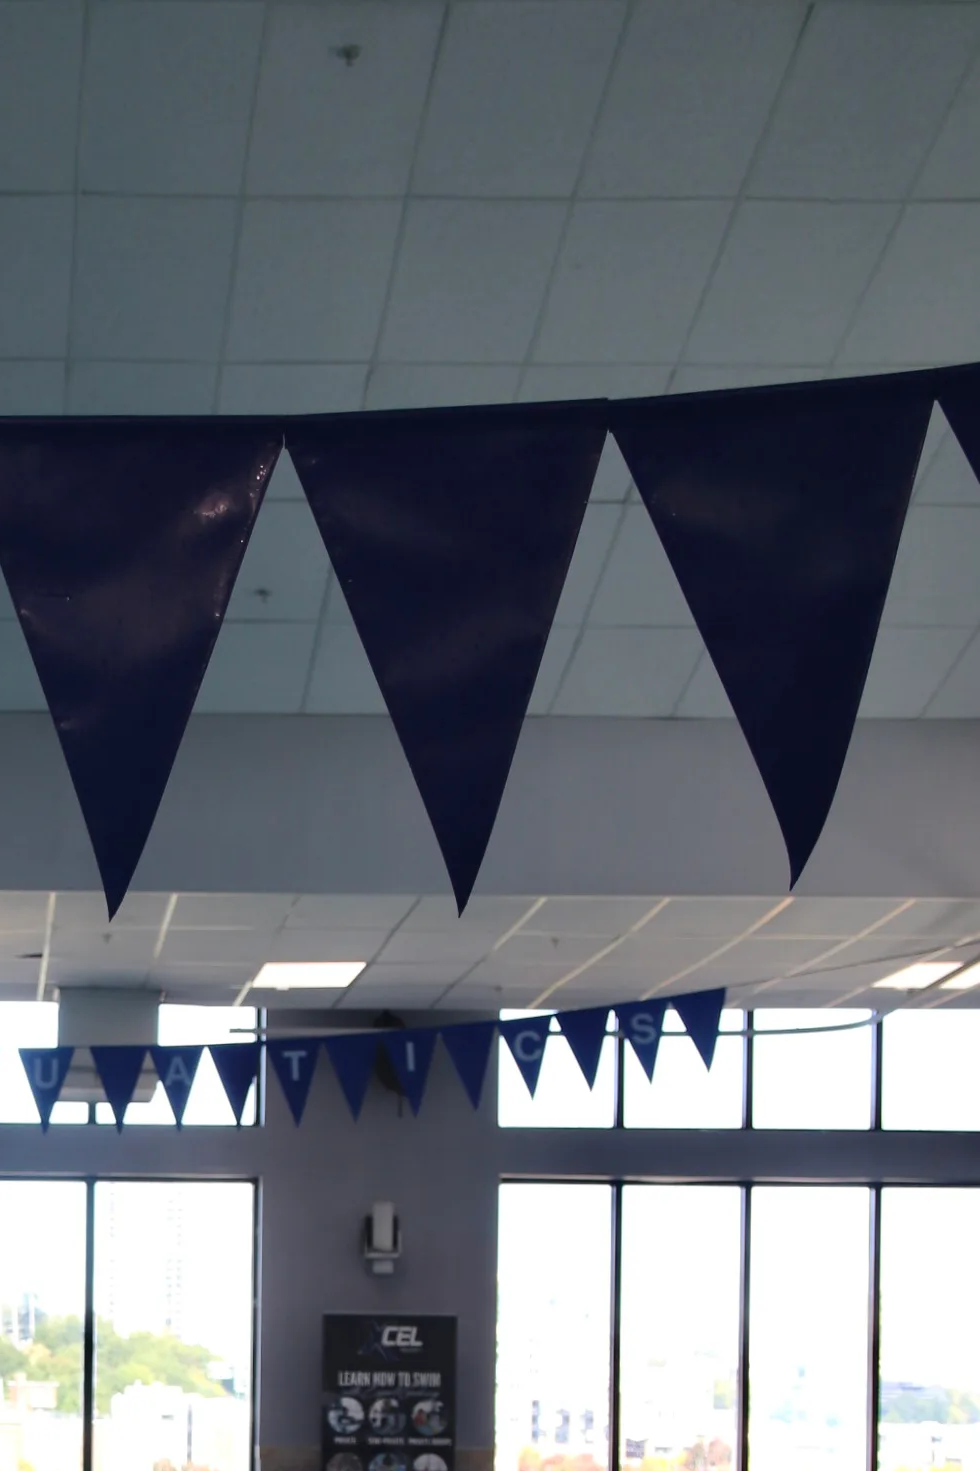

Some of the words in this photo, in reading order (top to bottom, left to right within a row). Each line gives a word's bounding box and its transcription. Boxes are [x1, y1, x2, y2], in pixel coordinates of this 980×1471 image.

[338, 1371, 371, 1388] LEARN
[372, 1372, 396, 1388] HOW
[398, 1372, 411, 1388] TO
[412, 1372, 442, 1388] SWIM
